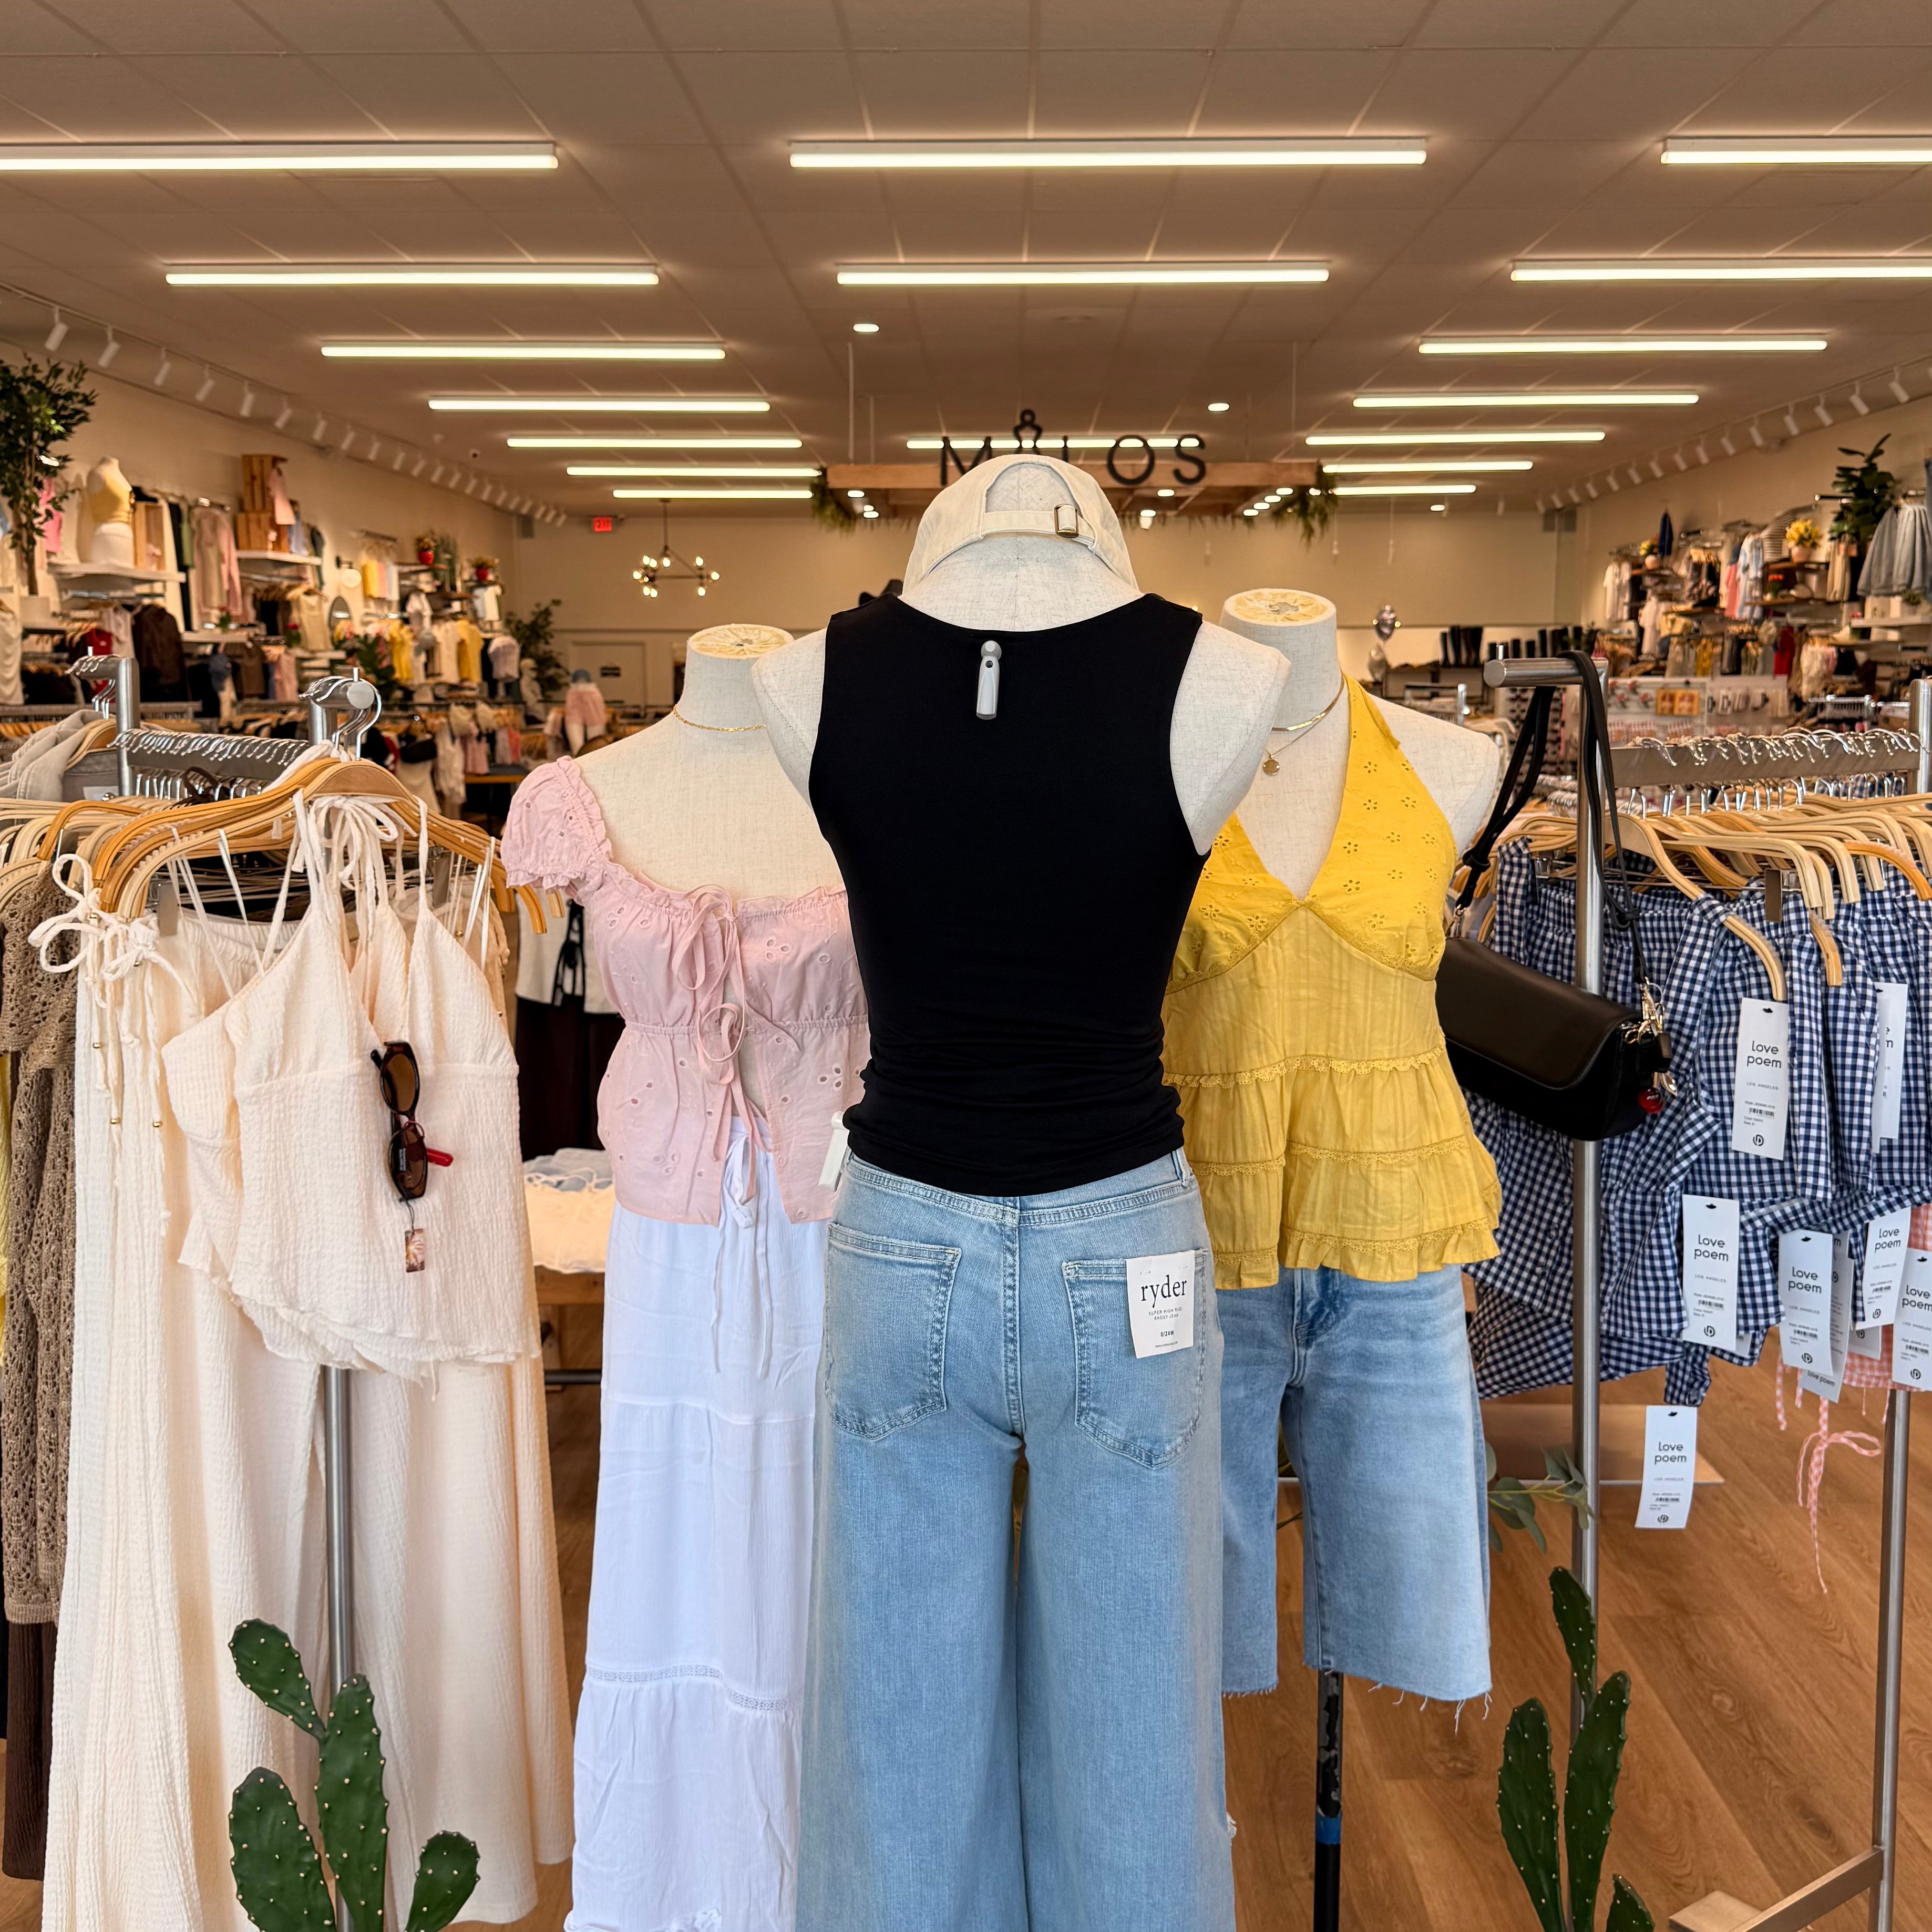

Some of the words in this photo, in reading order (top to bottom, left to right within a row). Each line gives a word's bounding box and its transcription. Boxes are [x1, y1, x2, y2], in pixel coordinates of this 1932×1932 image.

[1746, 1055, 1782, 1068] poem
[1874, 1238, 1901, 1253] poem
[1694, 1248, 1729, 1262] poem
[1140, 1274, 1187, 1309] ryder
[1788, 1279, 1822, 1294] poem
[1902, 1298, 1932, 1312] poem
[1654, 1454, 1687, 1465] poem
